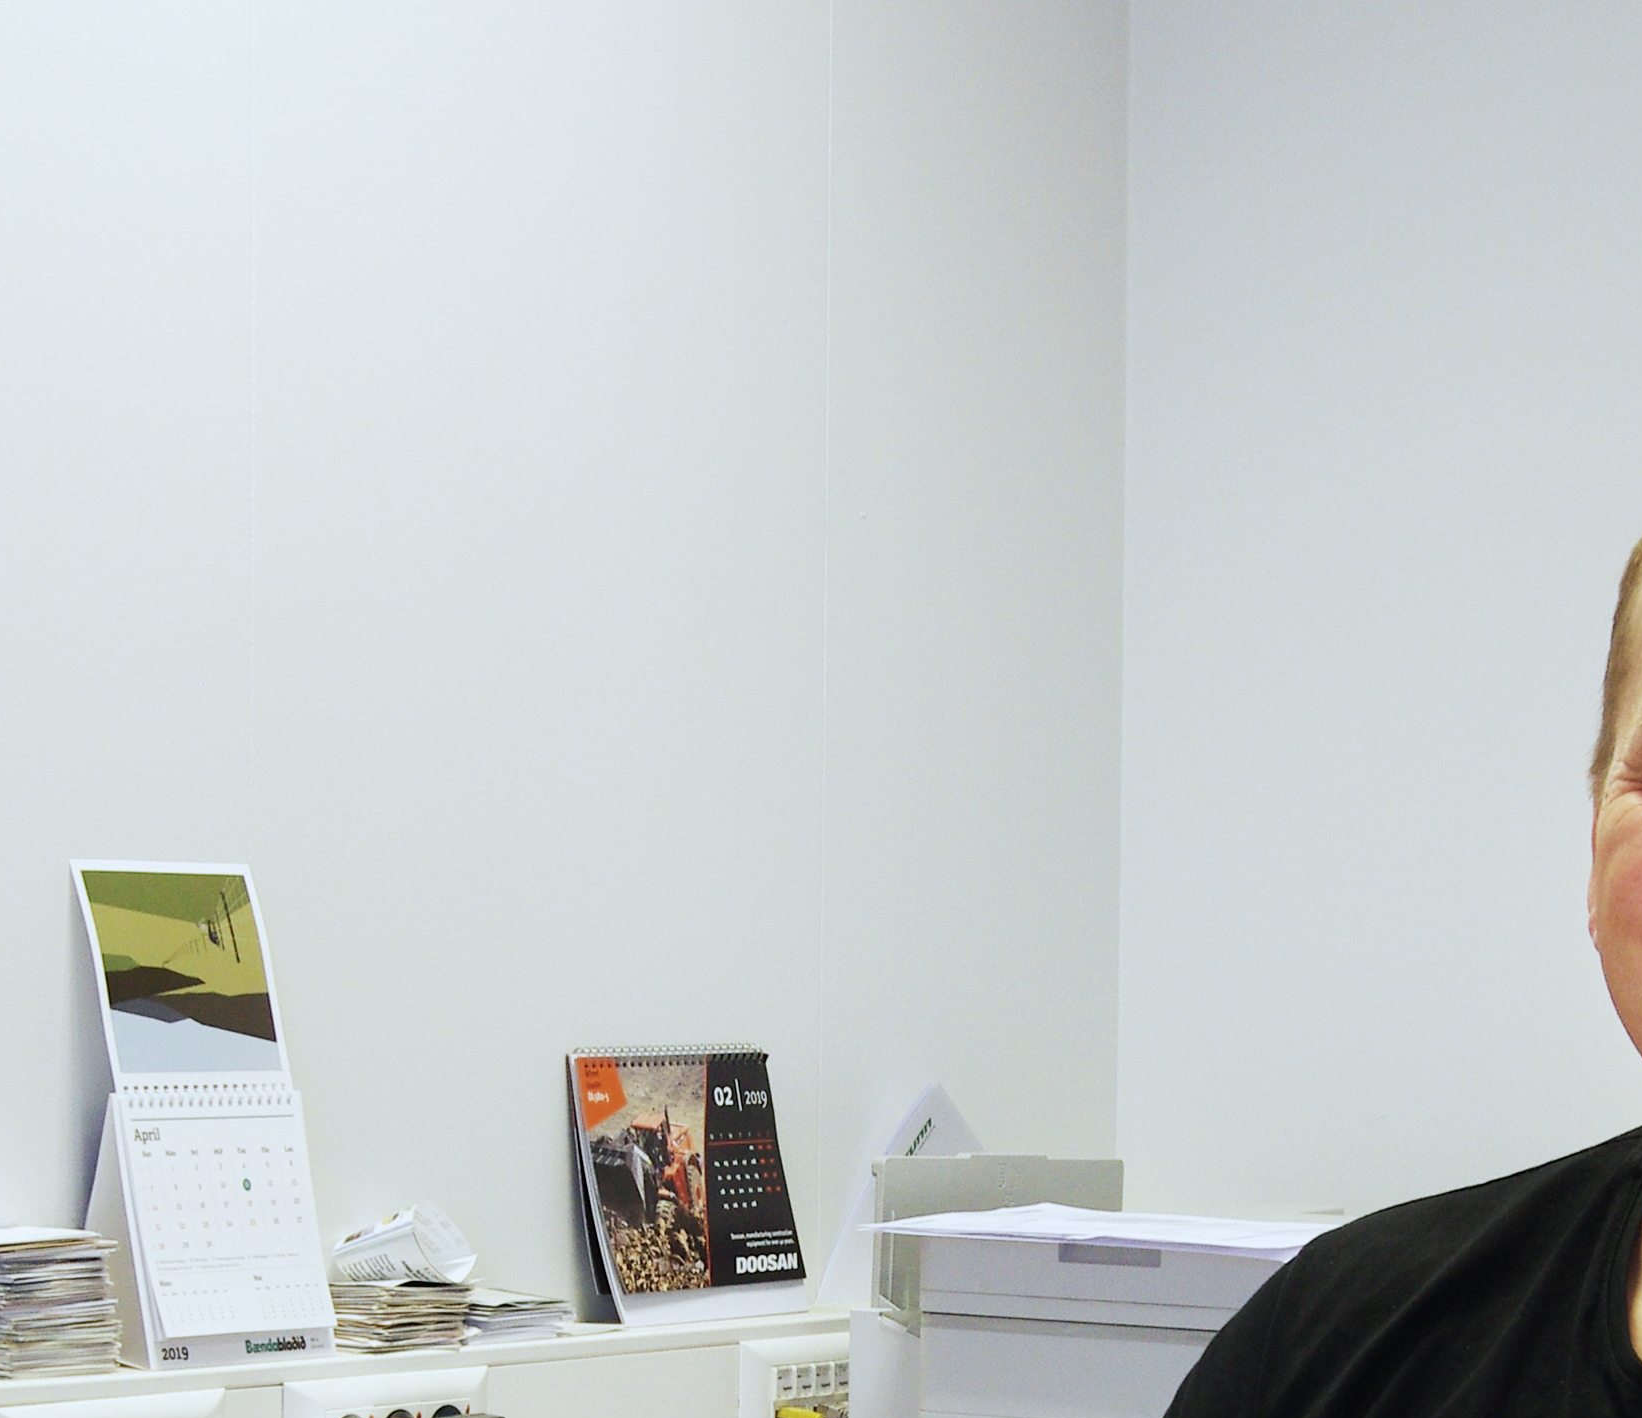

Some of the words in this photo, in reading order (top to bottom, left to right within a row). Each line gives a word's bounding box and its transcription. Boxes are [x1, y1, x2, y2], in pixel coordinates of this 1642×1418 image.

[713, 1086, 734, 1107] 02
[744, 1090, 768, 1109] 2019
[735, 1252, 798, 1274] DOOSAN
[162, 1347, 189, 1360] 2019
[245, 1335, 306, 1354] Bændablaðið
